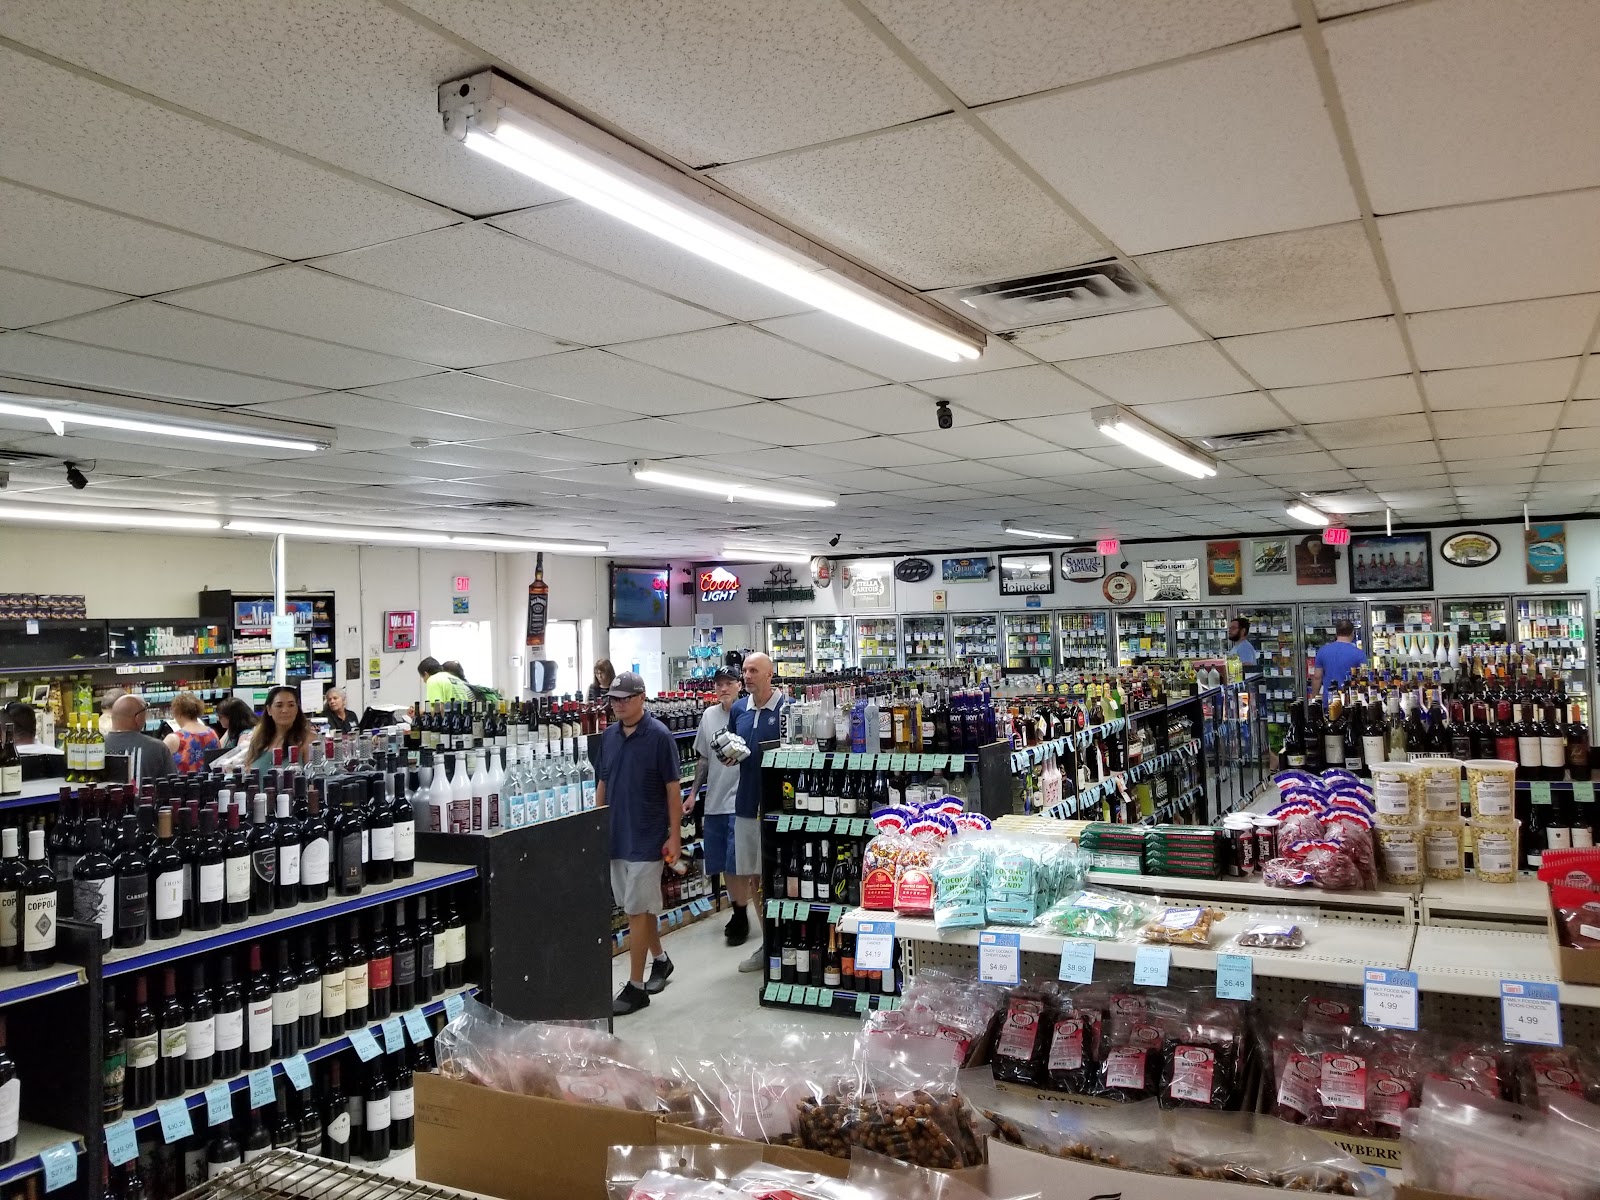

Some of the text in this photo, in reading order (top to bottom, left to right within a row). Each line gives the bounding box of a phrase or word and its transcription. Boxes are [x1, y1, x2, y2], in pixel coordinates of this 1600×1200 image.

[1326, 529, 1349, 544] EXIT
[1066, 557, 1101, 567] SAMUEL
[1069, 564, 1098, 574] ADAMS
[457, 577, 470, 591] EXIT
[700, 572, 740, 591] Coors
[702, 589, 738, 602] LIGHT
[252, 605, 307, 625] Maroro
[390, 615, 414, 627] We I.D.
[864, 950, 882, 958] $4.19
[1066, 963, 1087, 973] $8.99
[1143, 966, 1159, 974] 2.99
[1223, 978, 1245, 988] $6.49
[1379, 1001, 1398, 1010] 4.99
[1518, 1015, 1538, 1025] 4.99
[1334, 1140, 1402, 1161] WBERR
